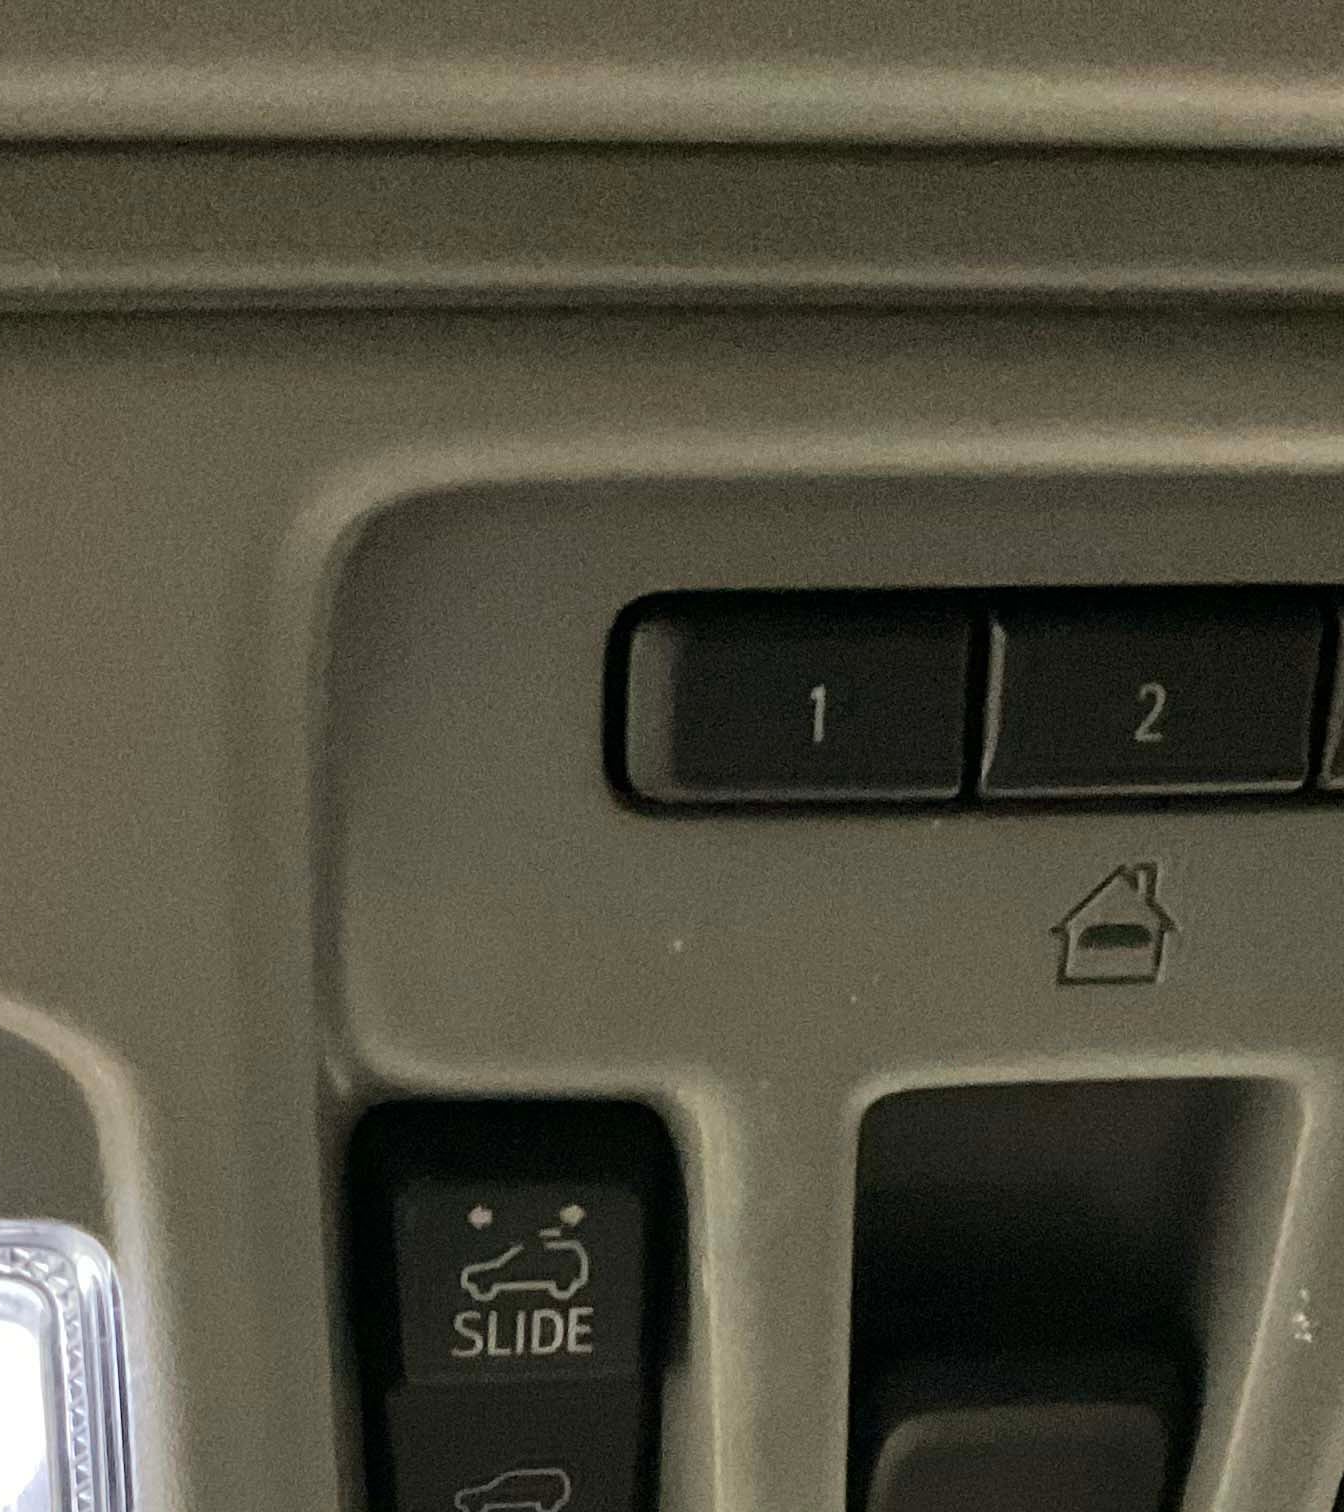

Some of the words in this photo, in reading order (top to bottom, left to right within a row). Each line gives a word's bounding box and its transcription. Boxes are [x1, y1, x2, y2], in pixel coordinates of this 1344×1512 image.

[808, 684, 829, 744] 1
[1134, 684, 1169, 743] 2
[451, 1306, 595, 1357] SLIDE
